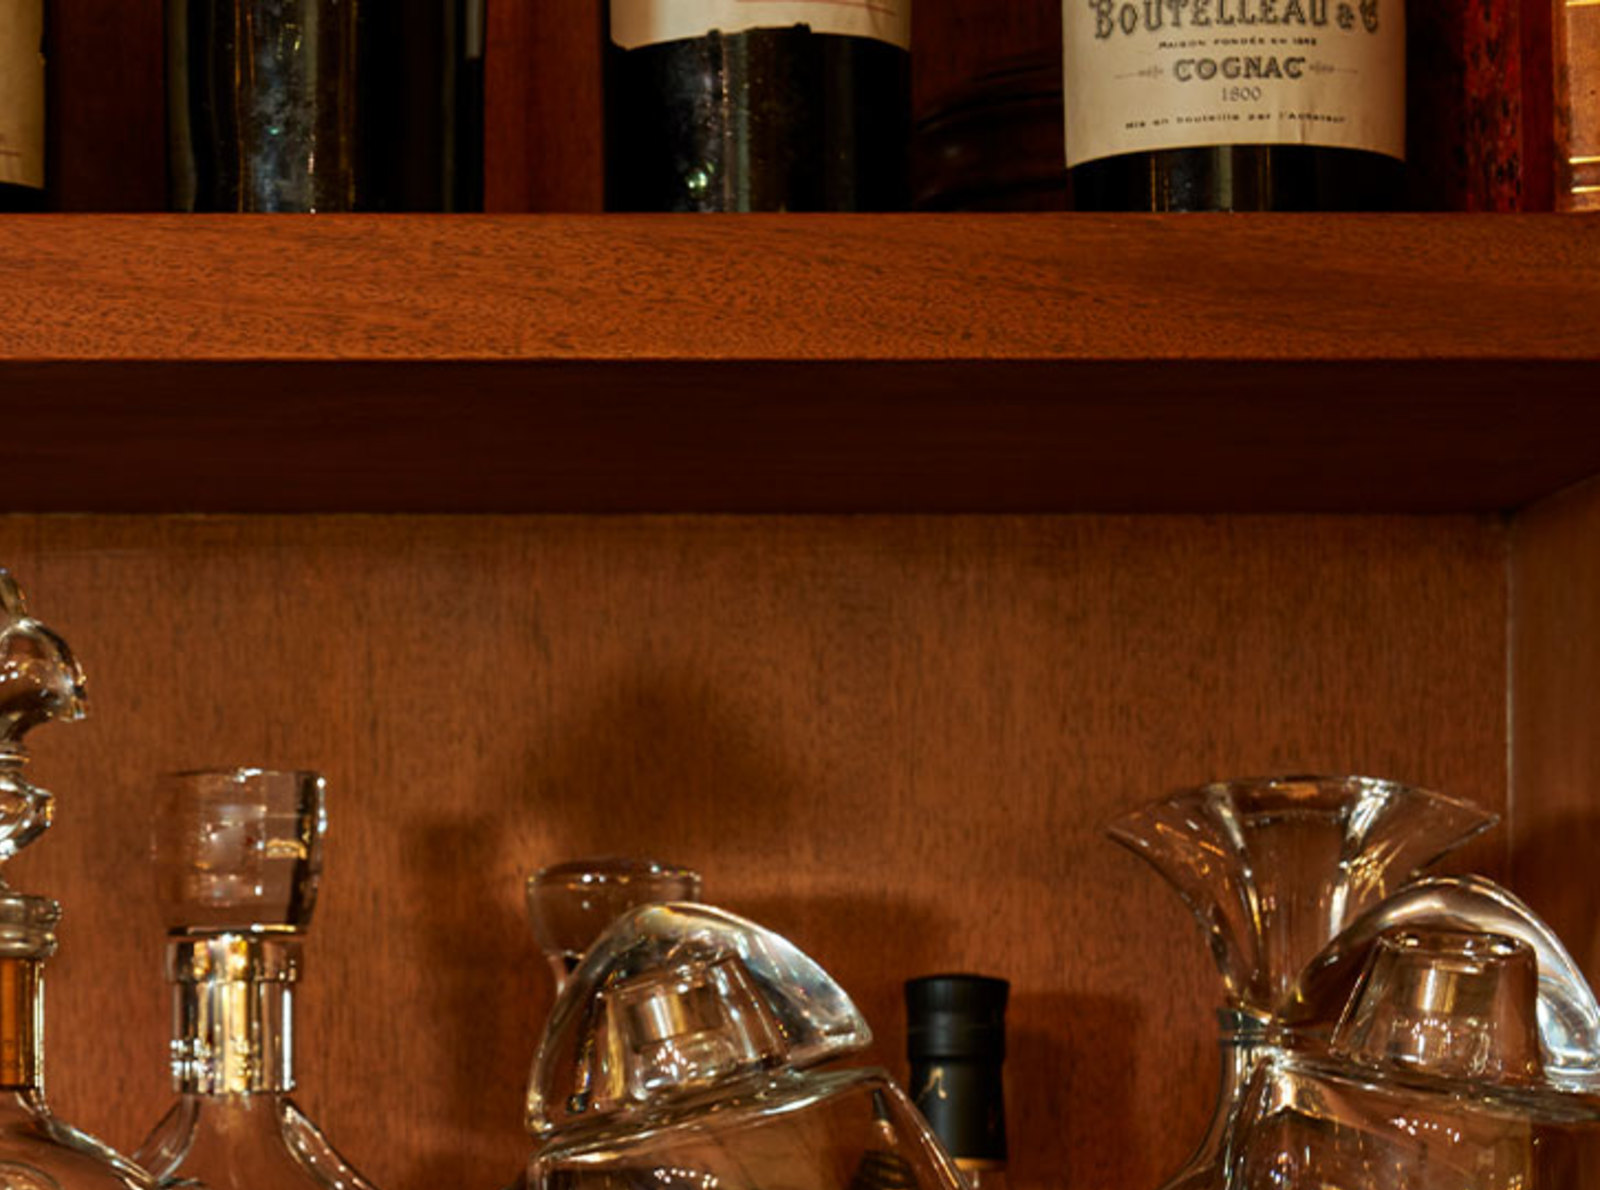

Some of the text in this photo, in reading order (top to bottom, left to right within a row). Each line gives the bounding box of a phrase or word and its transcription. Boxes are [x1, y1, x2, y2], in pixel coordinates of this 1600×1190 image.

[1158, 39, 1206, 49] MAISON
[1173, 57, 1305, 82] COGNAC
[1221, 86, 1262, 102] 1800
